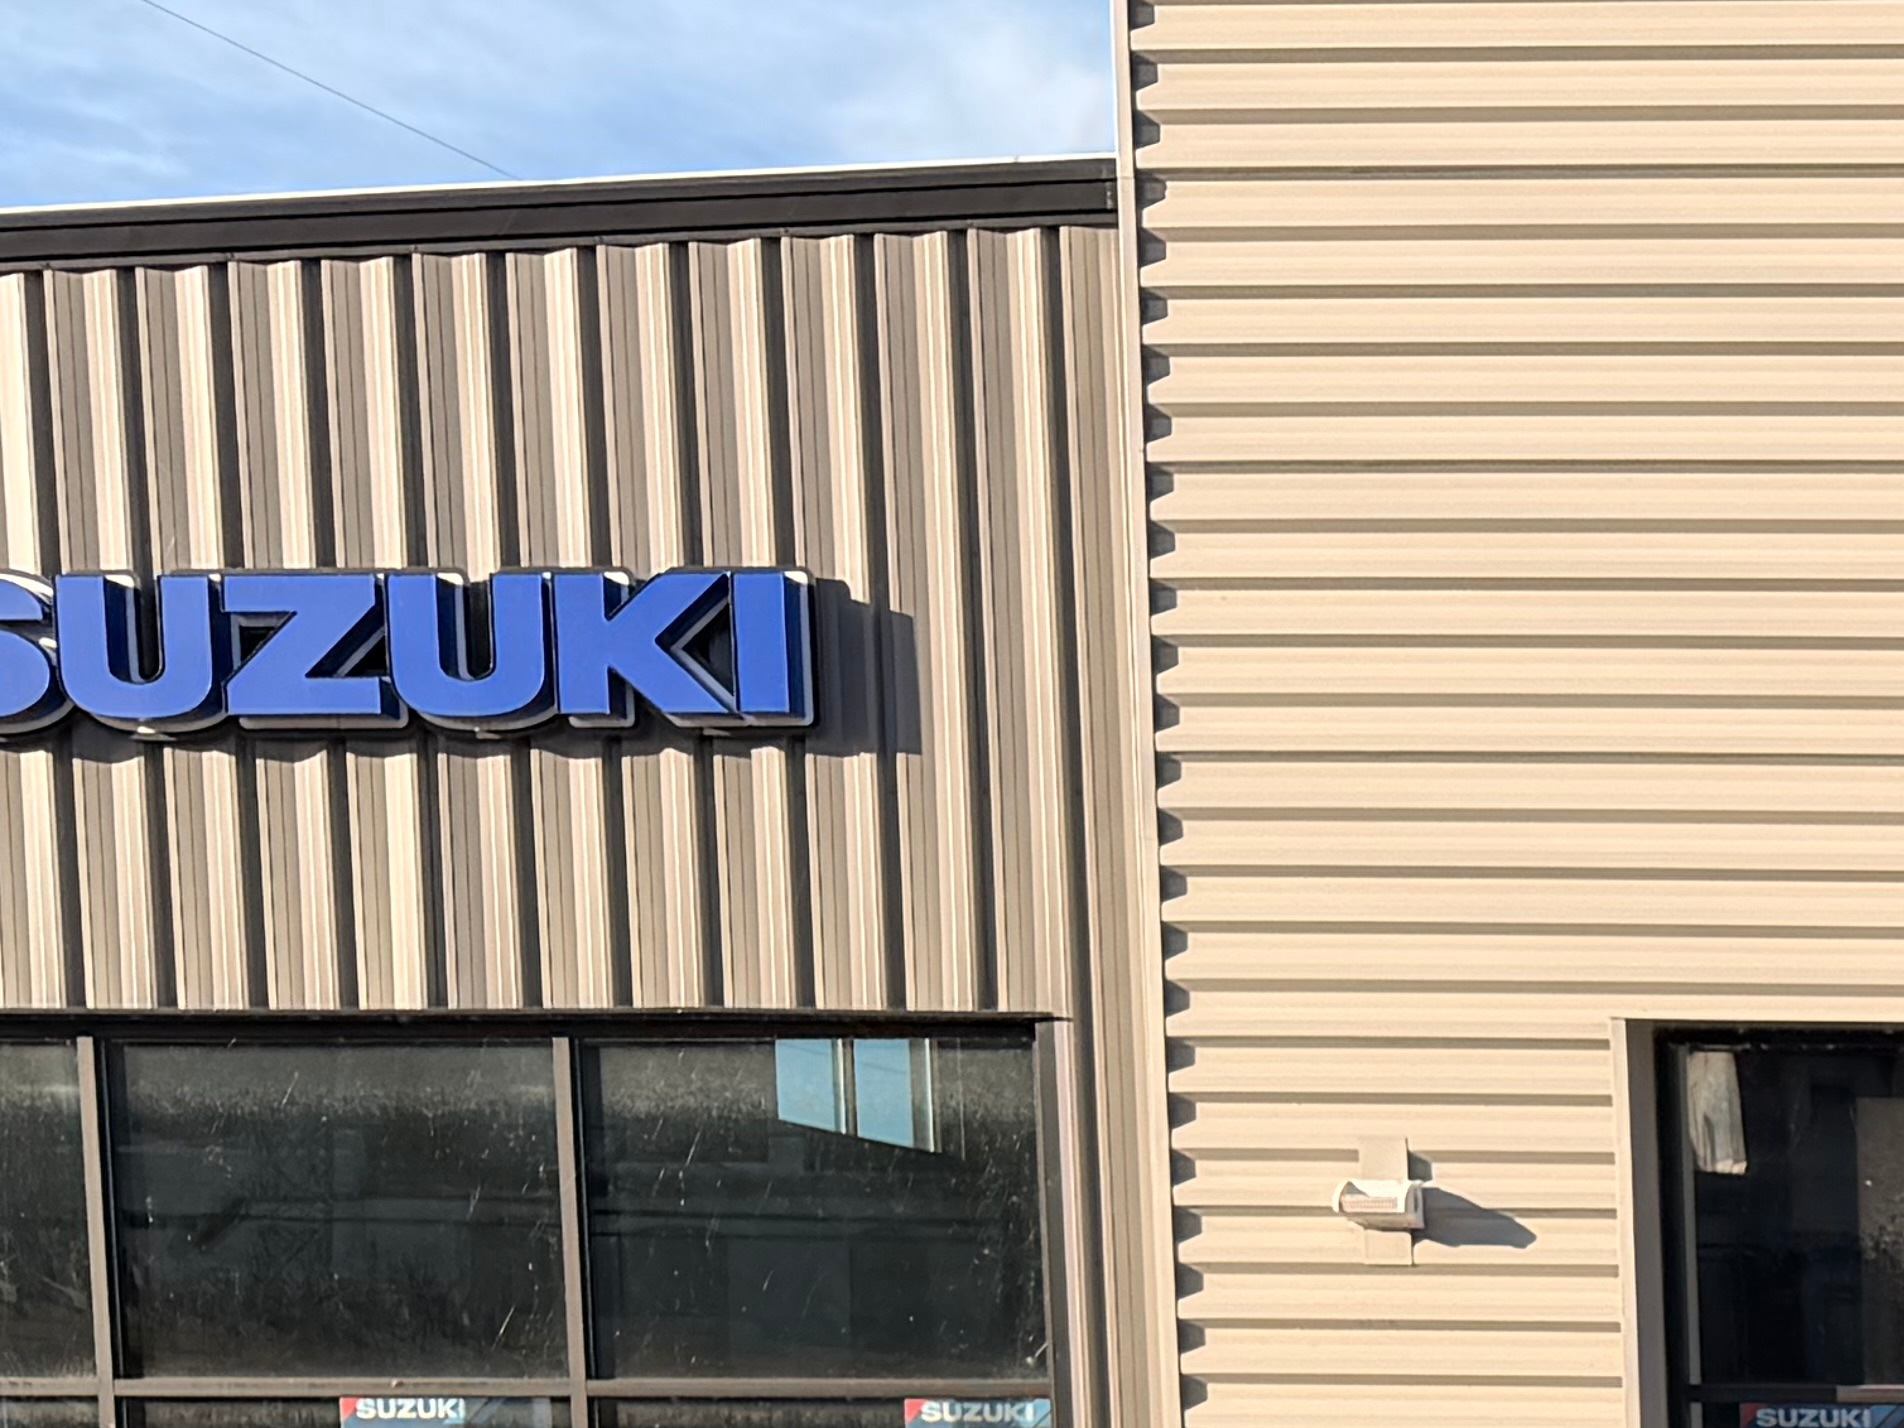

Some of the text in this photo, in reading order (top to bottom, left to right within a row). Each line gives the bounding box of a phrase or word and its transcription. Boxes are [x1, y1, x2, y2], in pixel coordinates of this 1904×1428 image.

[355, 1397, 466, 1420] SUZUKI
[920, 1400, 1036, 1423] SUZUKI
[1755, 1407, 1872, 1428] SUZUKI
